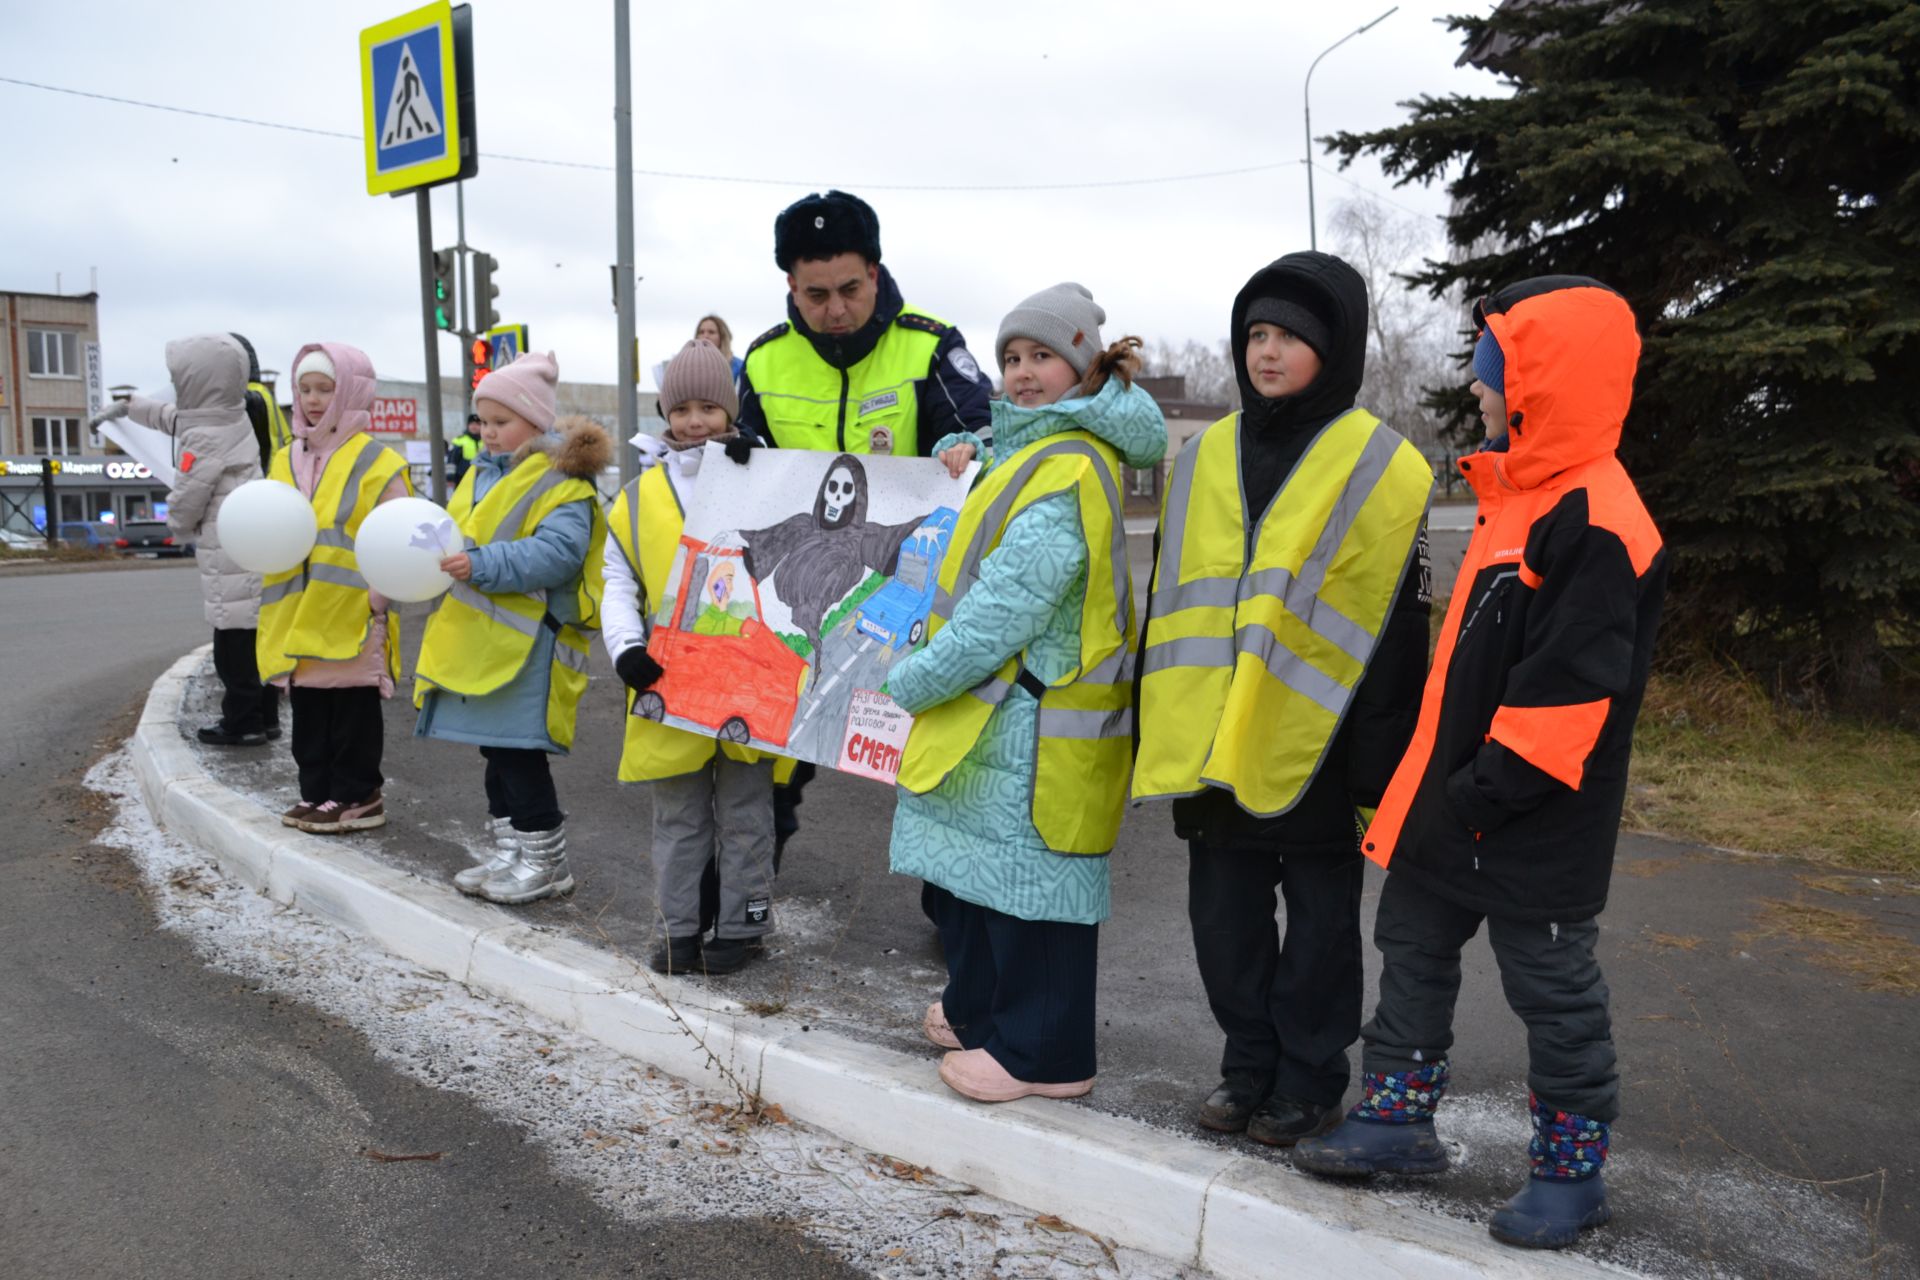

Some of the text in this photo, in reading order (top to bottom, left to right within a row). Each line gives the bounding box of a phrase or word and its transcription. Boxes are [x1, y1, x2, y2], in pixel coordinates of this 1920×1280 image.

[6, 461, 103, 476] Яндек Маркет
[106, 462, 153, 479] OZO
